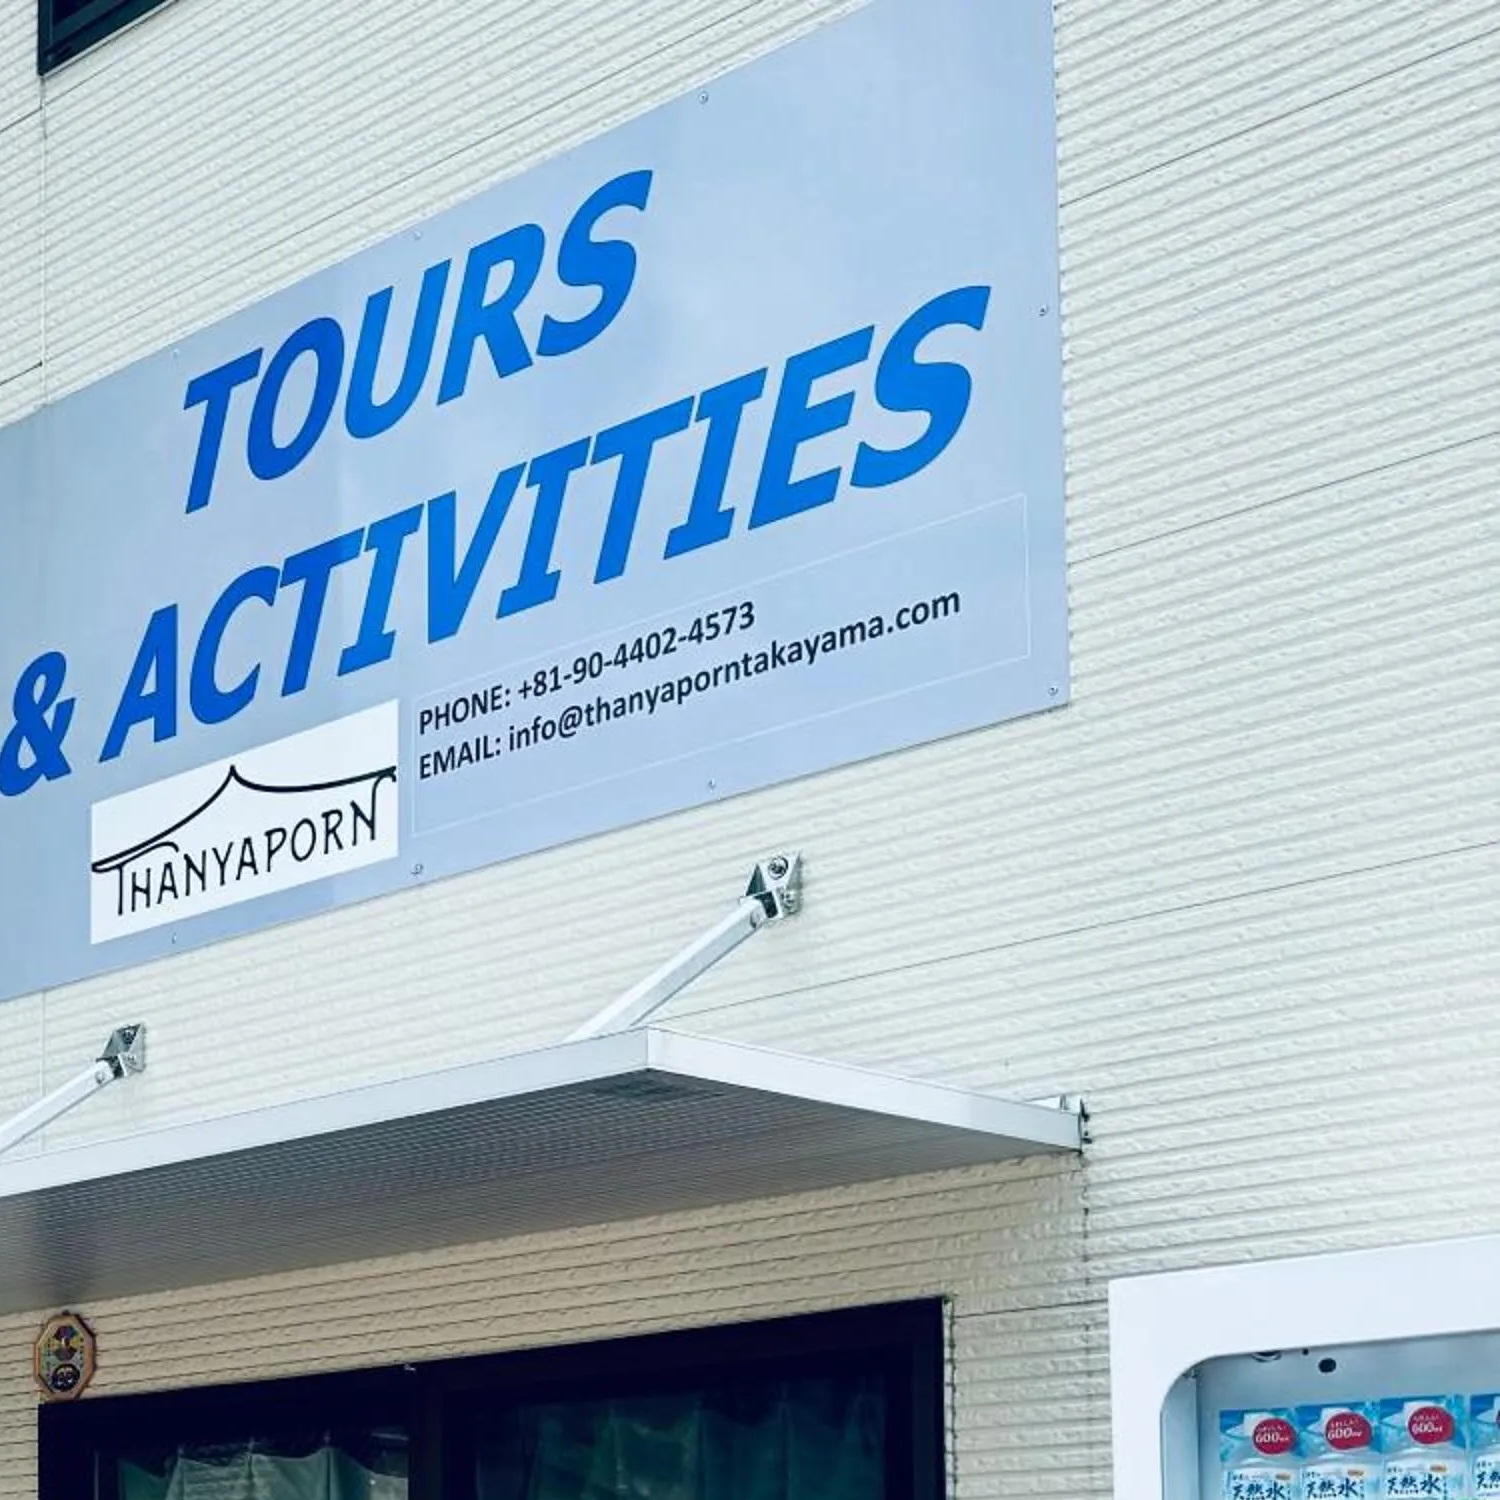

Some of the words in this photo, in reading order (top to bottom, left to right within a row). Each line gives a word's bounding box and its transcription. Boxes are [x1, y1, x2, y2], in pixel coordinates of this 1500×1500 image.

[183, 170, 652, 514] TOURS
[99, 285, 991, 763] ACTIVITIES
[419, 685, 510, 735] PHONE:
[517, 601, 755, 701] +81-90-4402-4573
[419, 736, 501, 779] EMAIL:
[509, 591, 961, 753] info@thanyaporntakayama.com
[94, 768, 396, 915] THANYAPORN
[1306, 1476, 1358, 1499] 天然水
[1387, 1471, 1442, 1495] 天然水
